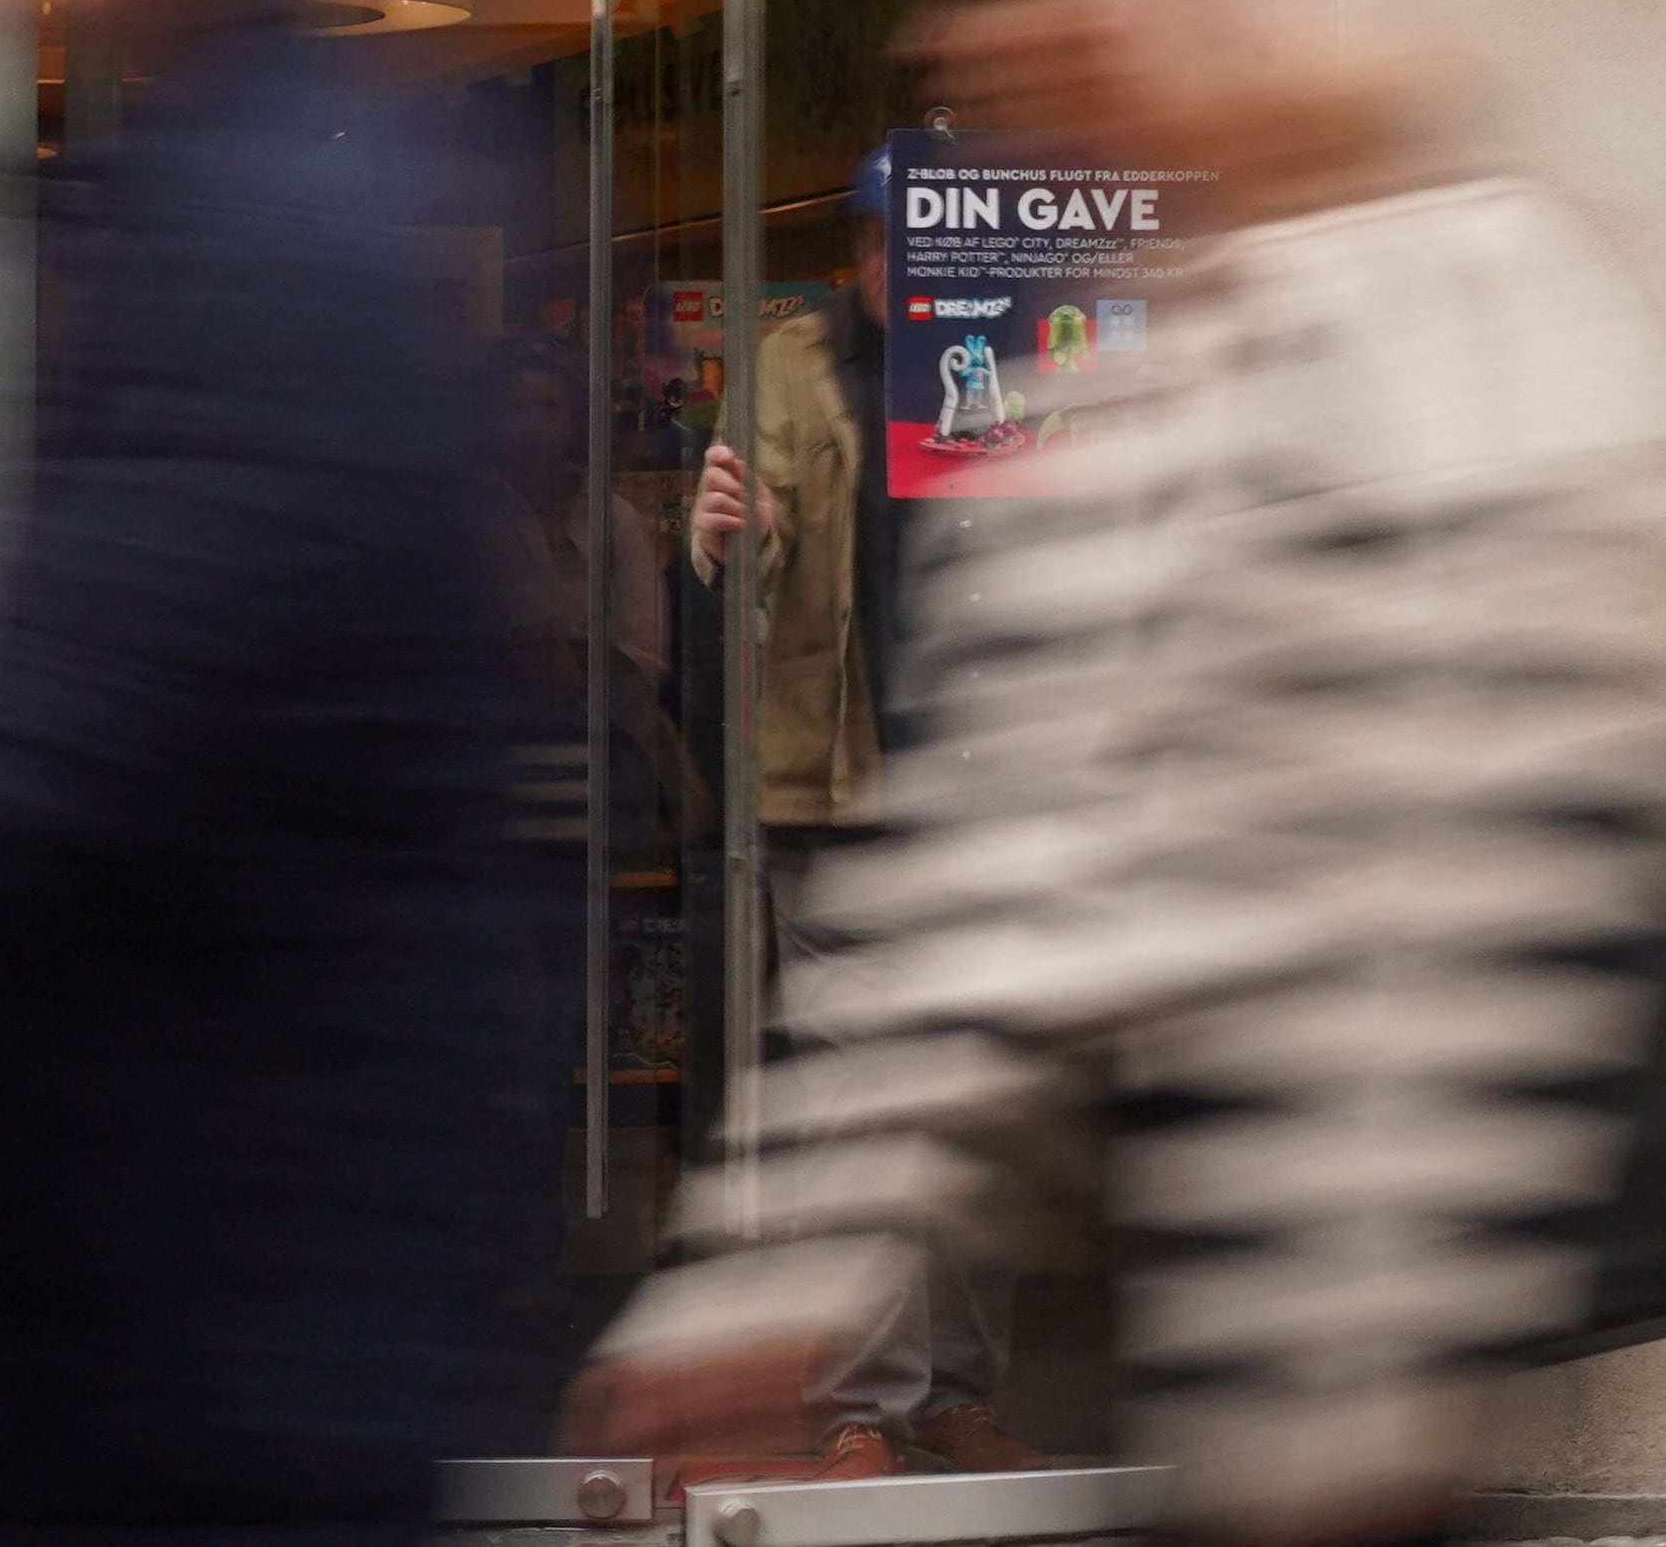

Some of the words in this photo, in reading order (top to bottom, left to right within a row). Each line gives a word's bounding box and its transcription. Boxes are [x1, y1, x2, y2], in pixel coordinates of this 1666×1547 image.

[958, 168, 979, 181] OG
[983, 168, 1046, 182] BUNCHUS
[1050, 169, 1092, 182] FLUGT
[1095, 169, 1120, 182] FRA
[1123, 170, 1220, 183] EDDERKOPPEN
[906, 187, 1000, 230] DIN
[1017, 187, 1160, 231] GAVE
[906, 237, 933, 248] VED
[964, 237, 981, 249] AF
[906, 267, 956, 278] MONKIE
[1066, 267, 1090, 279] FOR
[1093, 267, 1139, 279] MINDST
